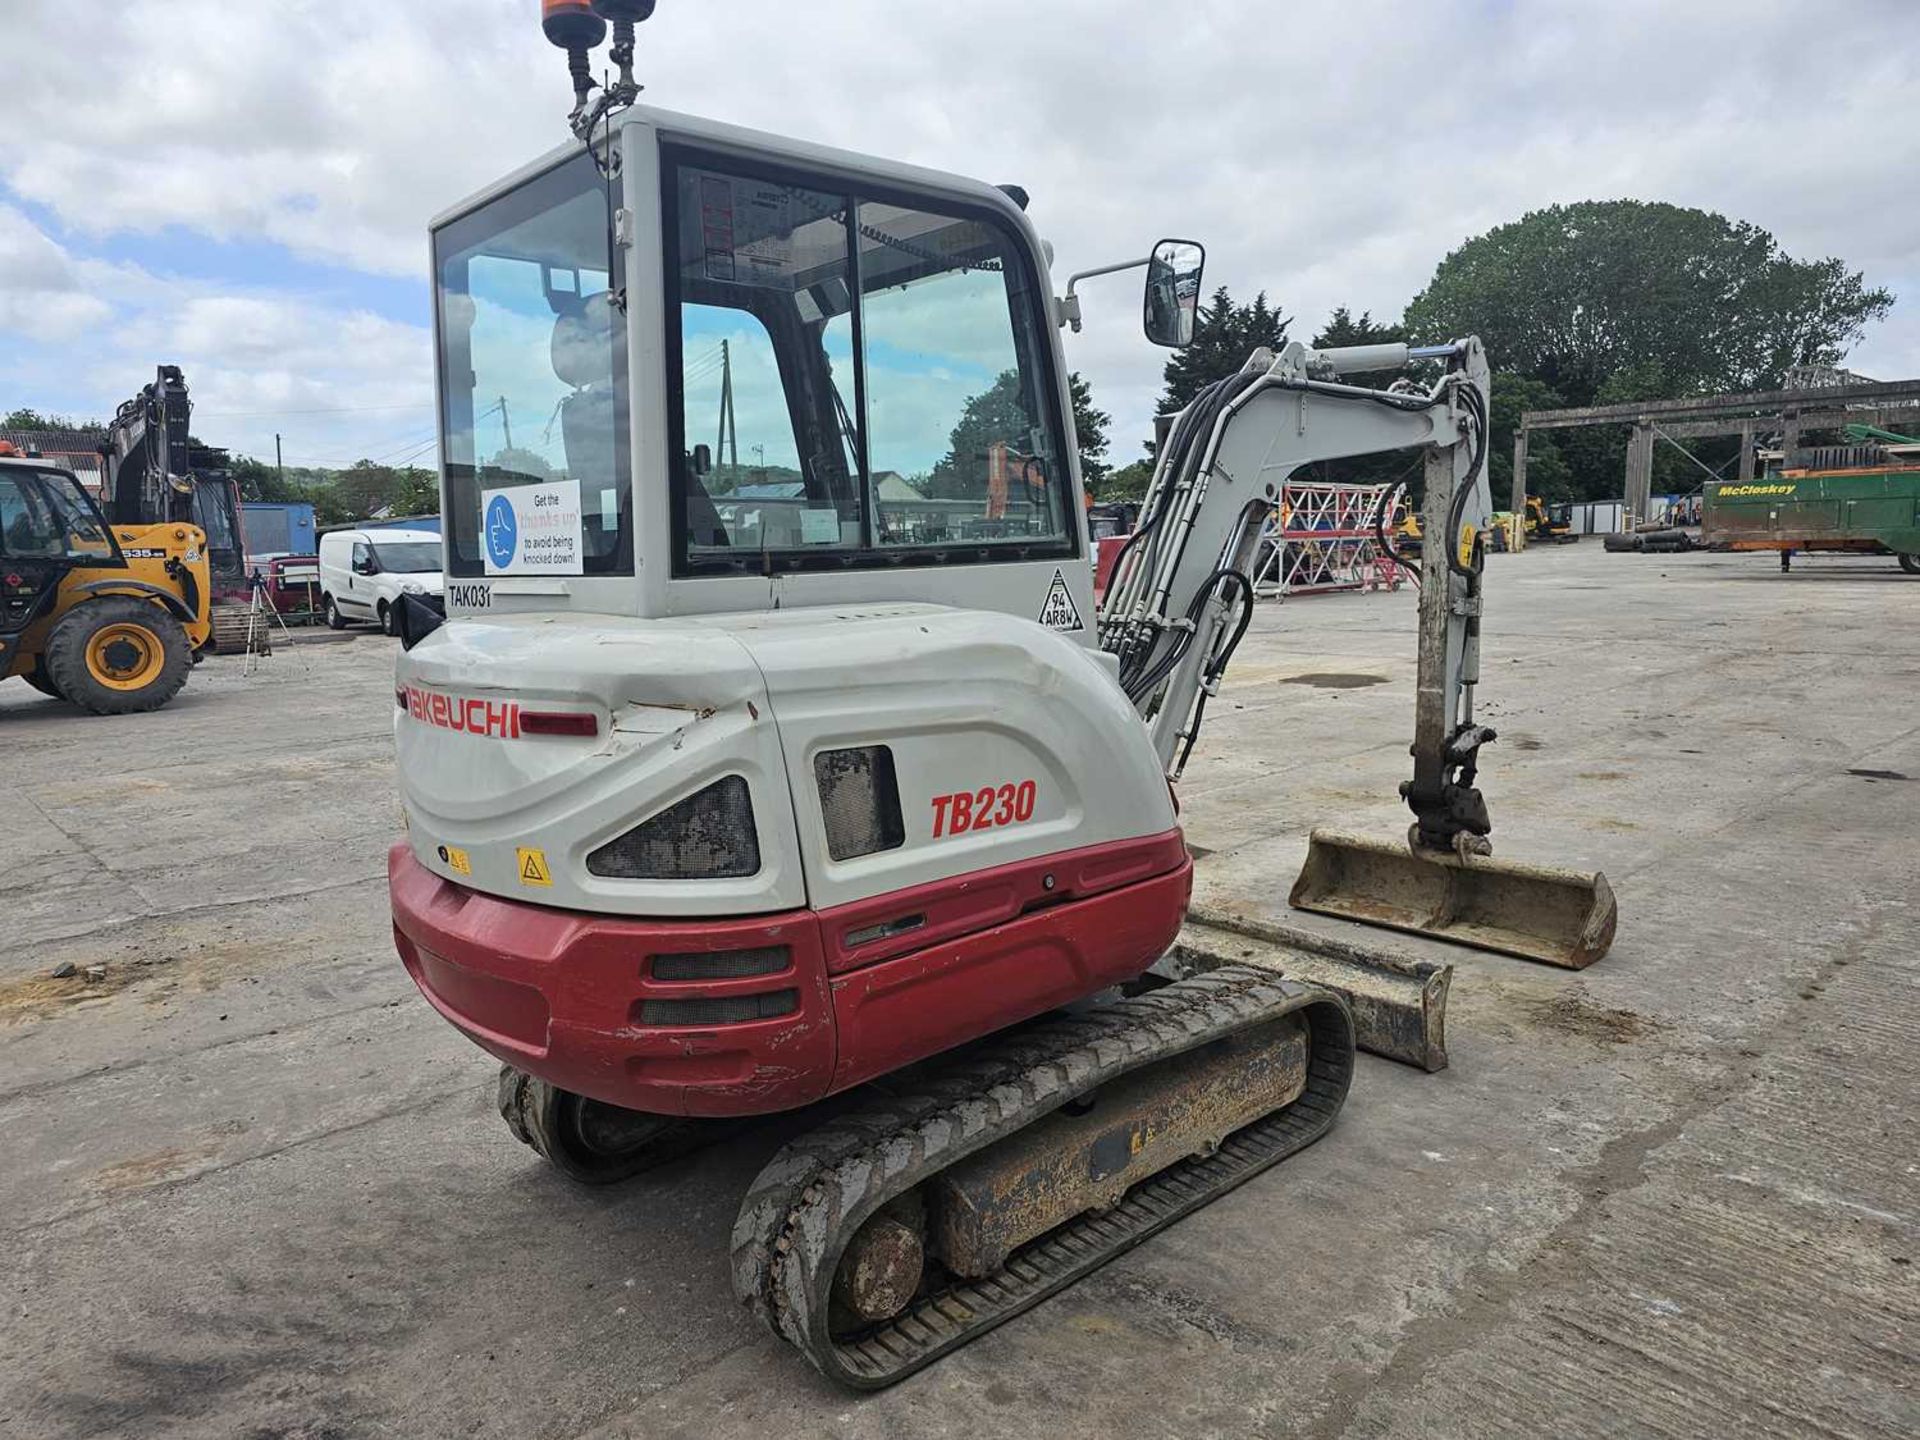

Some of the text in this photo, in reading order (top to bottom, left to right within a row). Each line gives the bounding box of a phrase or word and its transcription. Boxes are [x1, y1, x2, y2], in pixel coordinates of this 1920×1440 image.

[1718, 484, 1796, 496] McCloskey
[534, 493, 559, 507] Get the
[524, 535, 573, 550] to avoid being
[523, 552, 552, 564] knocked
[449, 585, 491, 608] TAK031
[1051, 593, 1065, 609] 94
[1046, 609, 1073, 626] AR8W
[932, 780, 1037, 839] TB230
